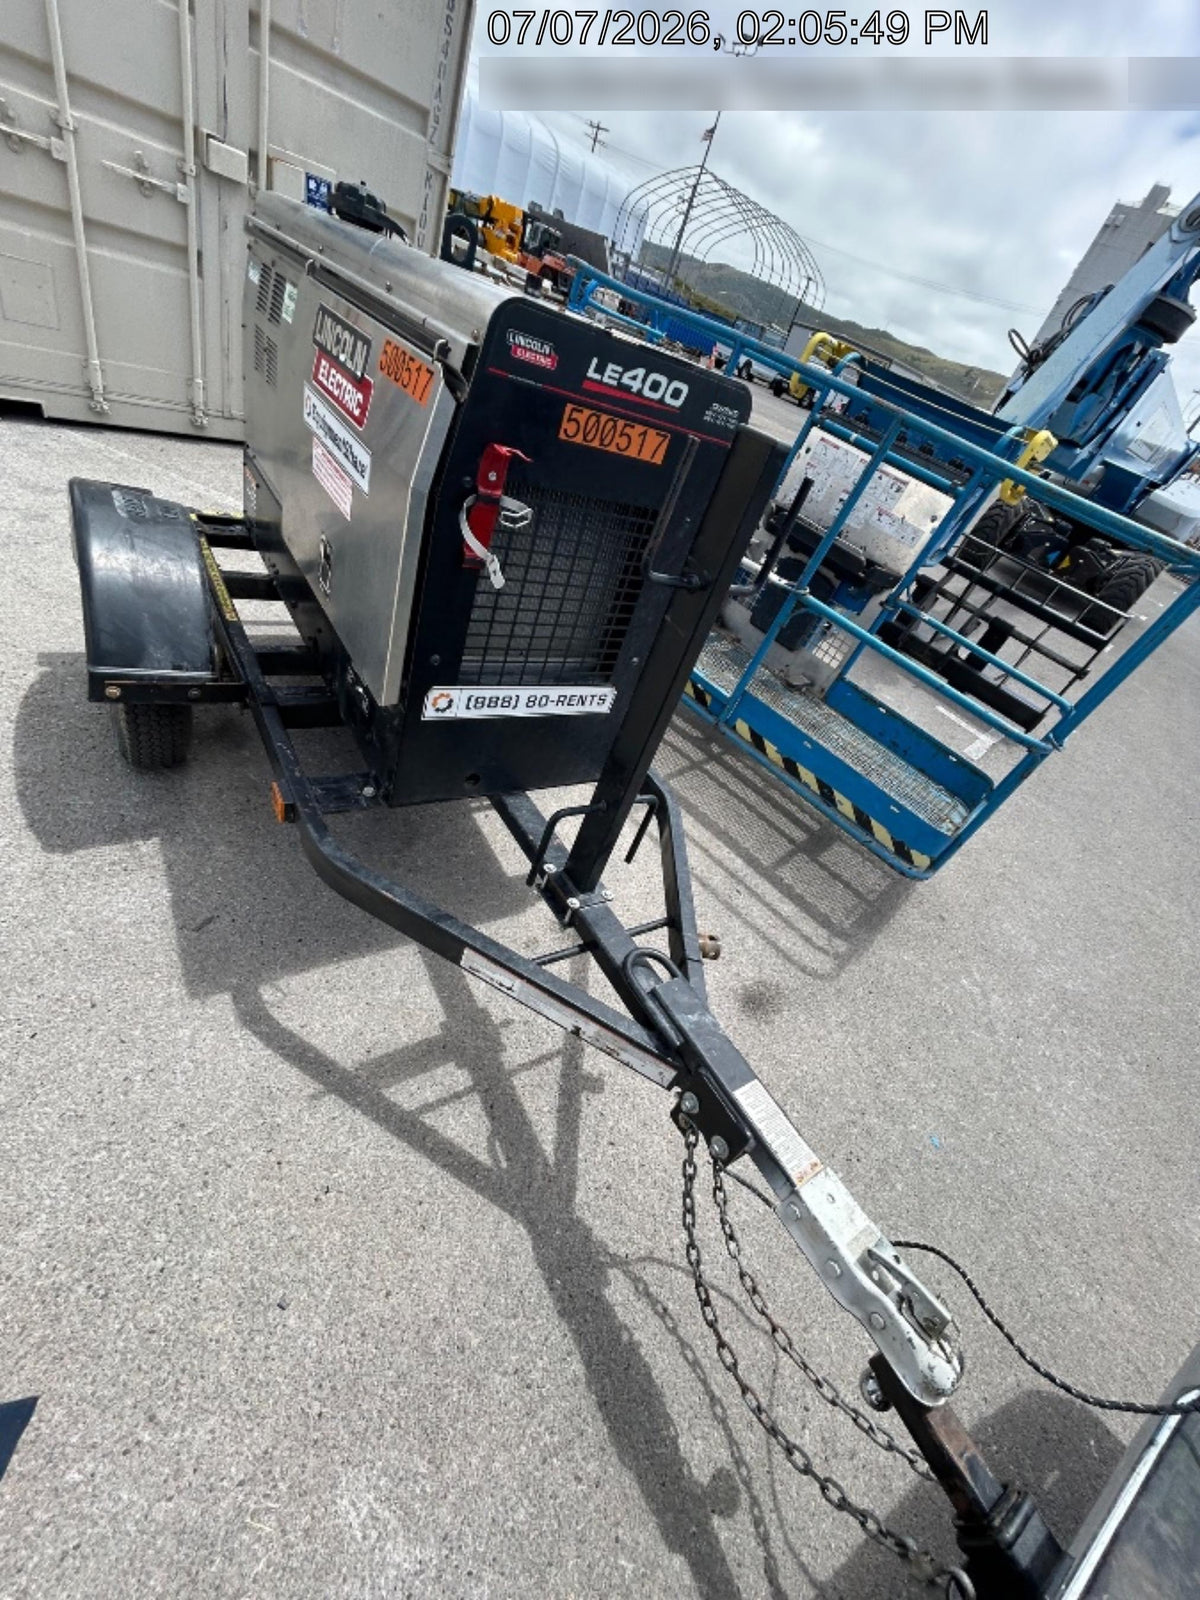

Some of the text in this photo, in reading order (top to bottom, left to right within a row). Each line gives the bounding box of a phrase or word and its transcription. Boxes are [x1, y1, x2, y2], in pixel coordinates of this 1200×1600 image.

[314, 309, 368, 380] LINCOLN
[508, 331, 551, 354] LINCOLN
[517, 347, 554, 368] ELECTRIC
[317, 357, 364, 418] ELECTRIC
[379, 339, 435, 402] 500517
[585, 356, 690, 408] LE400
[563, 406, 671, 461] 500517
[525, 693, 608, 709] 80-RENTS
